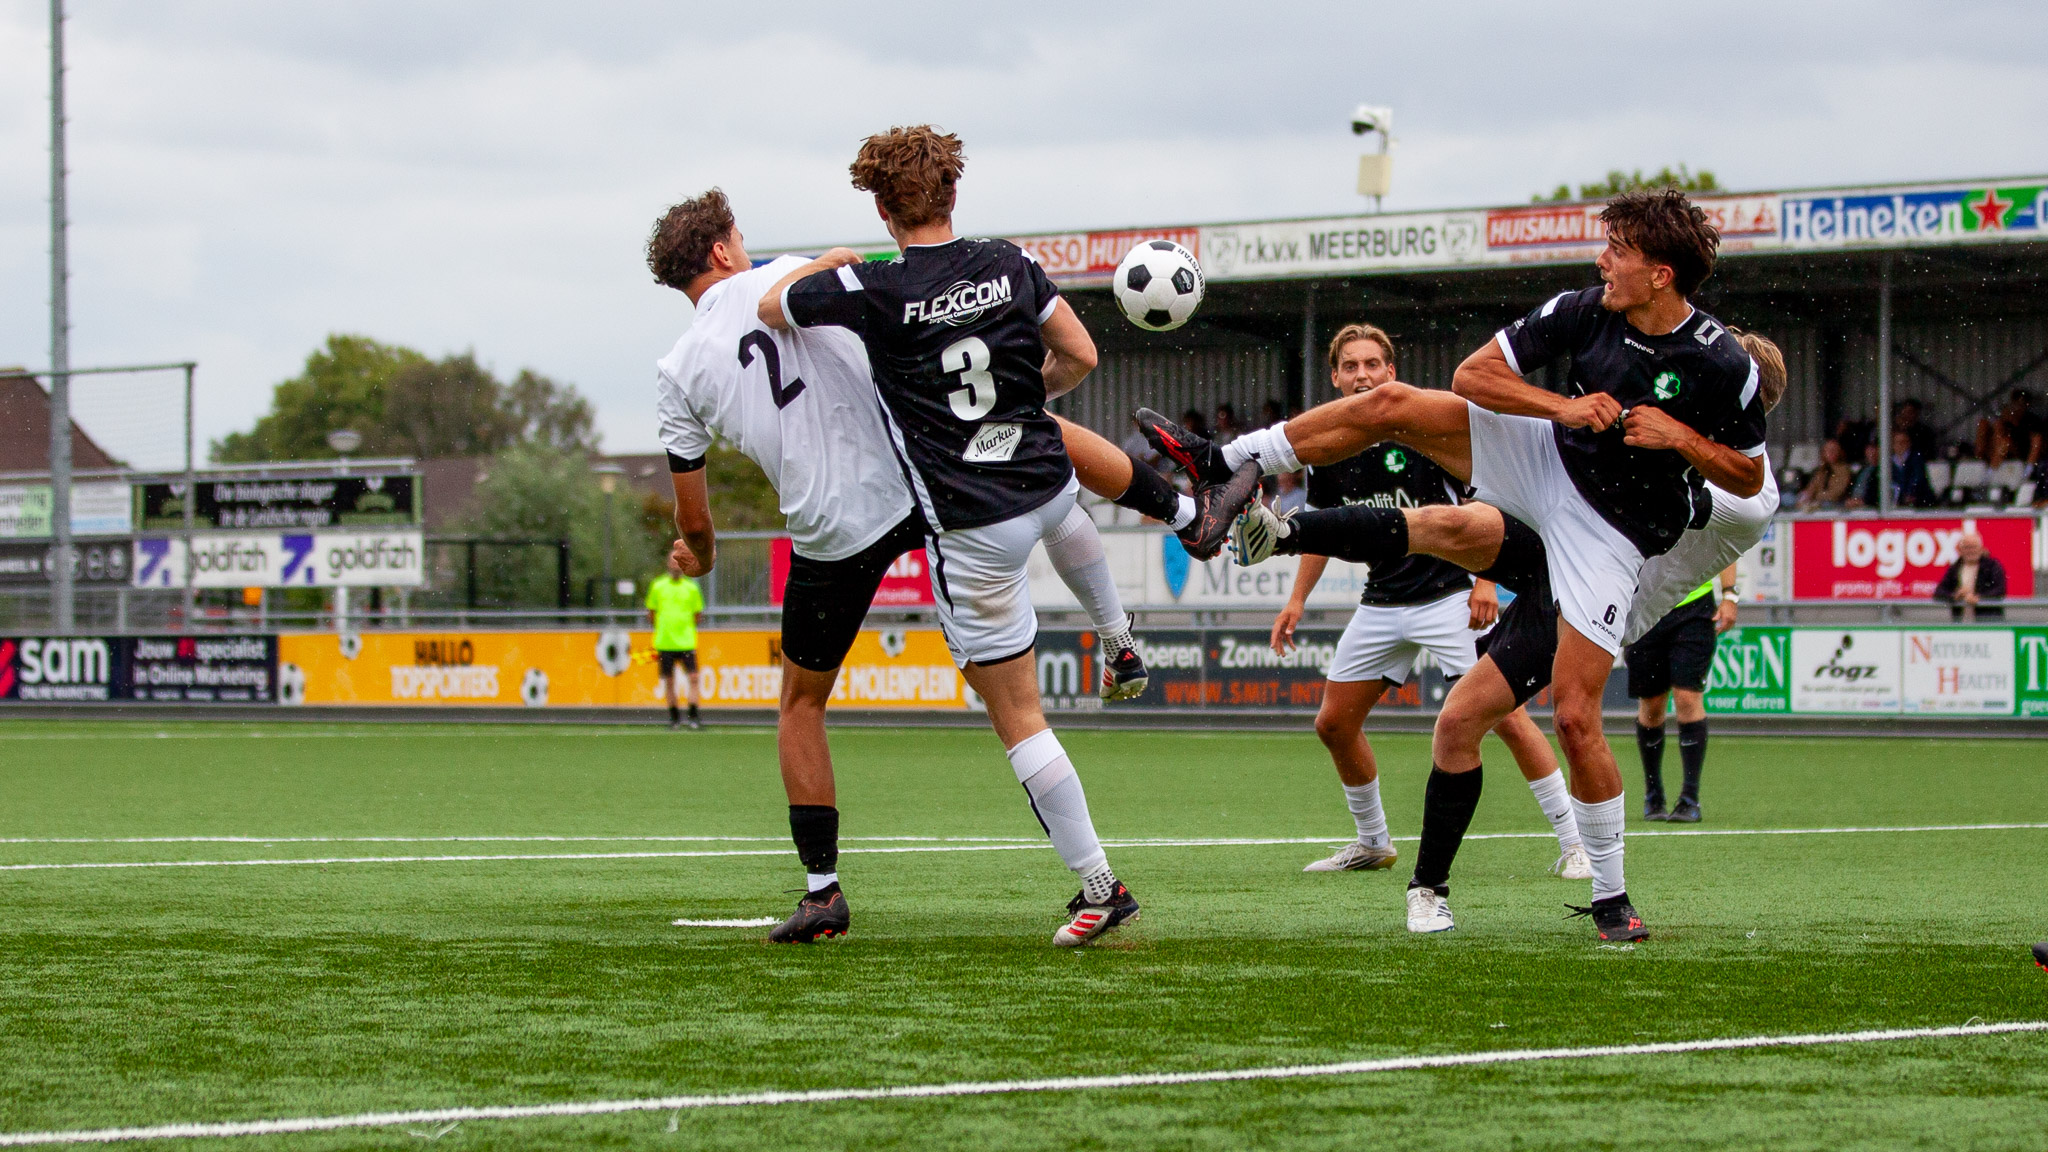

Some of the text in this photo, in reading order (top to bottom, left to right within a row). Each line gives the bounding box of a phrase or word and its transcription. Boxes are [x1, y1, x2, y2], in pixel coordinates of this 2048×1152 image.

[1490, 212, 1581, 244] HUISMAN
[1783, 195, 1964, 243] Heineken
[1309, 226, 1437, 261] MEERBURG
[903, 275, 1011, 324] FLEXCOM
[738, 329, 807, 410] 2
[942, 337, 997, 421] 3
[975, 424, 1017, 458] Markus
[328, 539, 417, 578] goldfizh
[1832, 581, 1873, 598] promo
[1603, 604, 1617, 625] 6
[19, 639, 109, 684] sam
[195, 638, 265, 664] specialist
[414, 639, 474, 666] HALLO
[1138, 636, 1202, 668] loeren
[1909, 635, 1992, 664] NATURAL
[149, 662, 193, 686] Online
[195, 663, 266, 691] Marketing
[390, 664, 499, 697] TOPSPORTERS
[849, 665, 957, 700] MOLENPLEIN
[1815, 663, 1880, 683] rogz
[1937, 666, 2009, 694] HEALTH
[1707, 696, 1738, 710] voor
[1742, 692, 1786, 711] dieren
